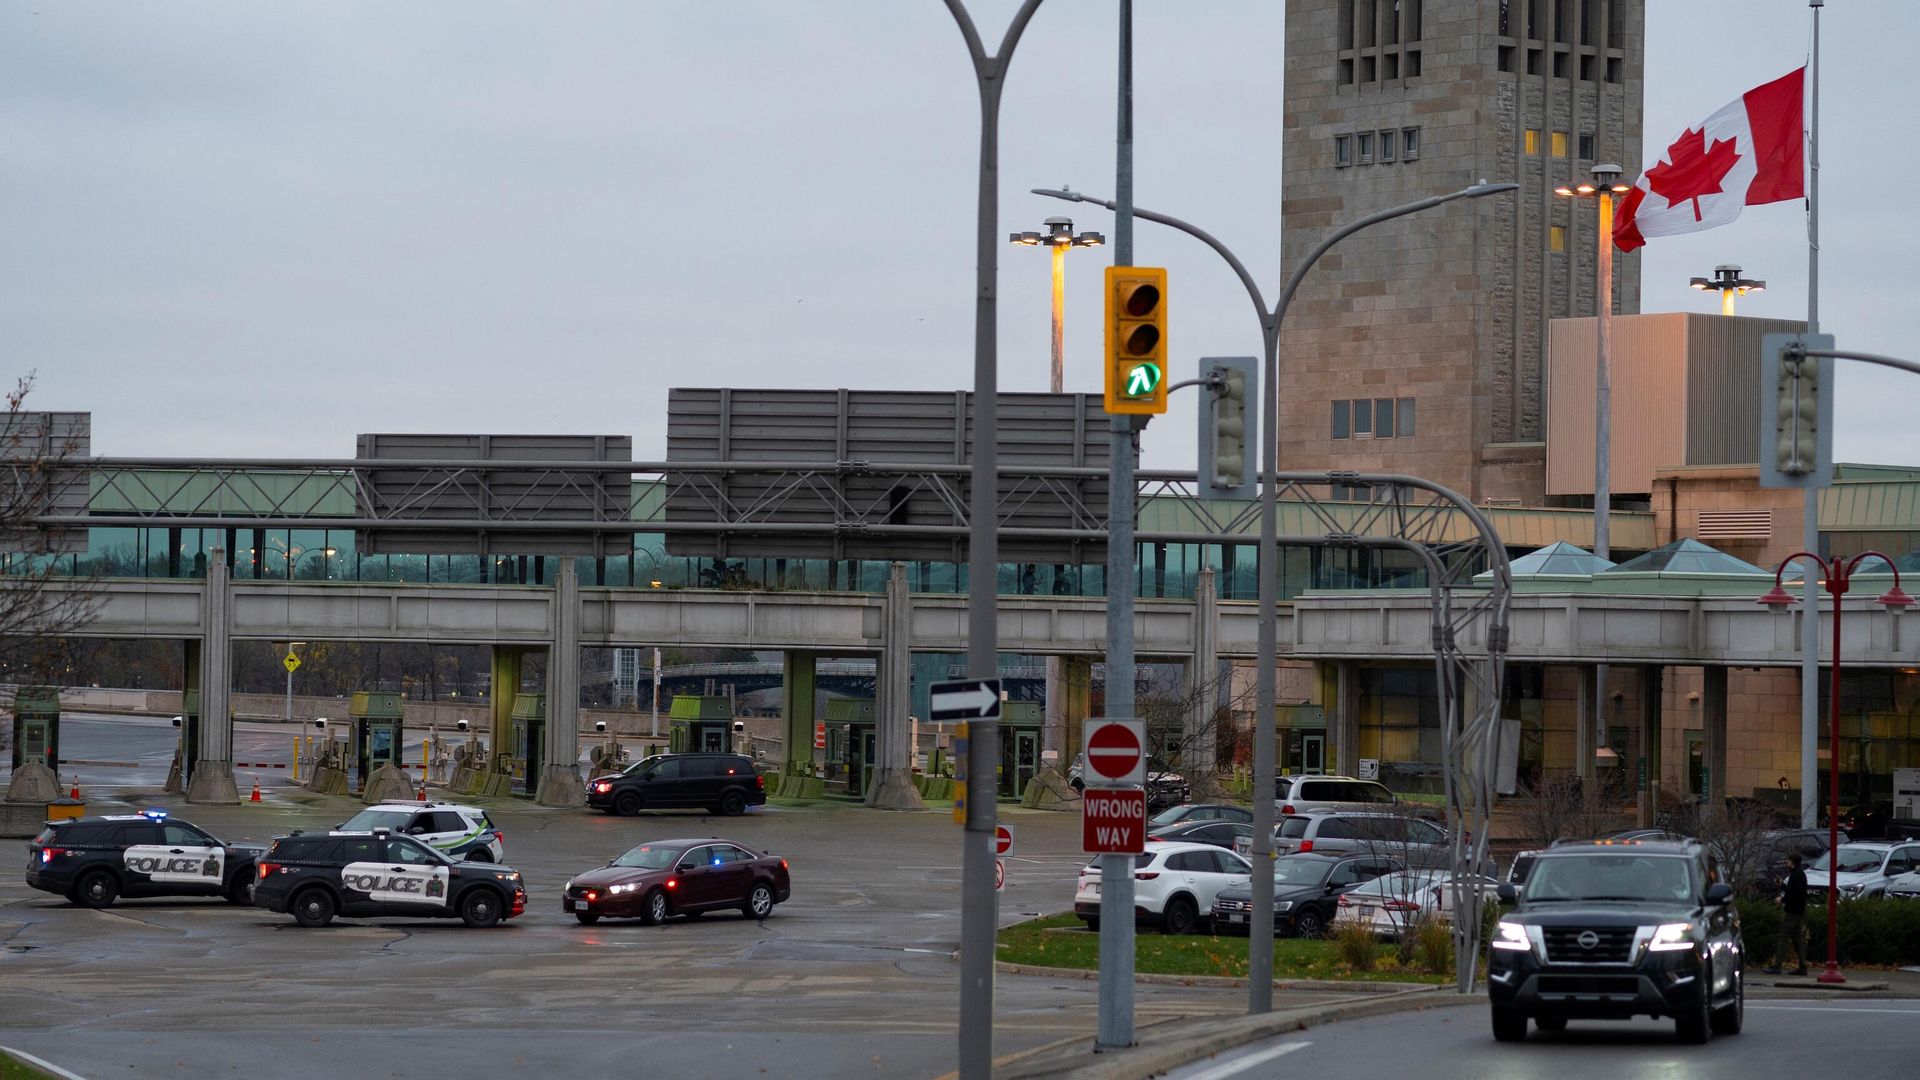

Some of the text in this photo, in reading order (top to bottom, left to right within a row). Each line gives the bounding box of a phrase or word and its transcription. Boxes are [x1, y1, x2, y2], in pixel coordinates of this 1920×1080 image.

[1085, 798, 1143, 818] WRONG
[1096, 826, 1131, 846] WAY
[125, 857, 201, 873] POLICE
[343, 874, 425, 893] POLICE
